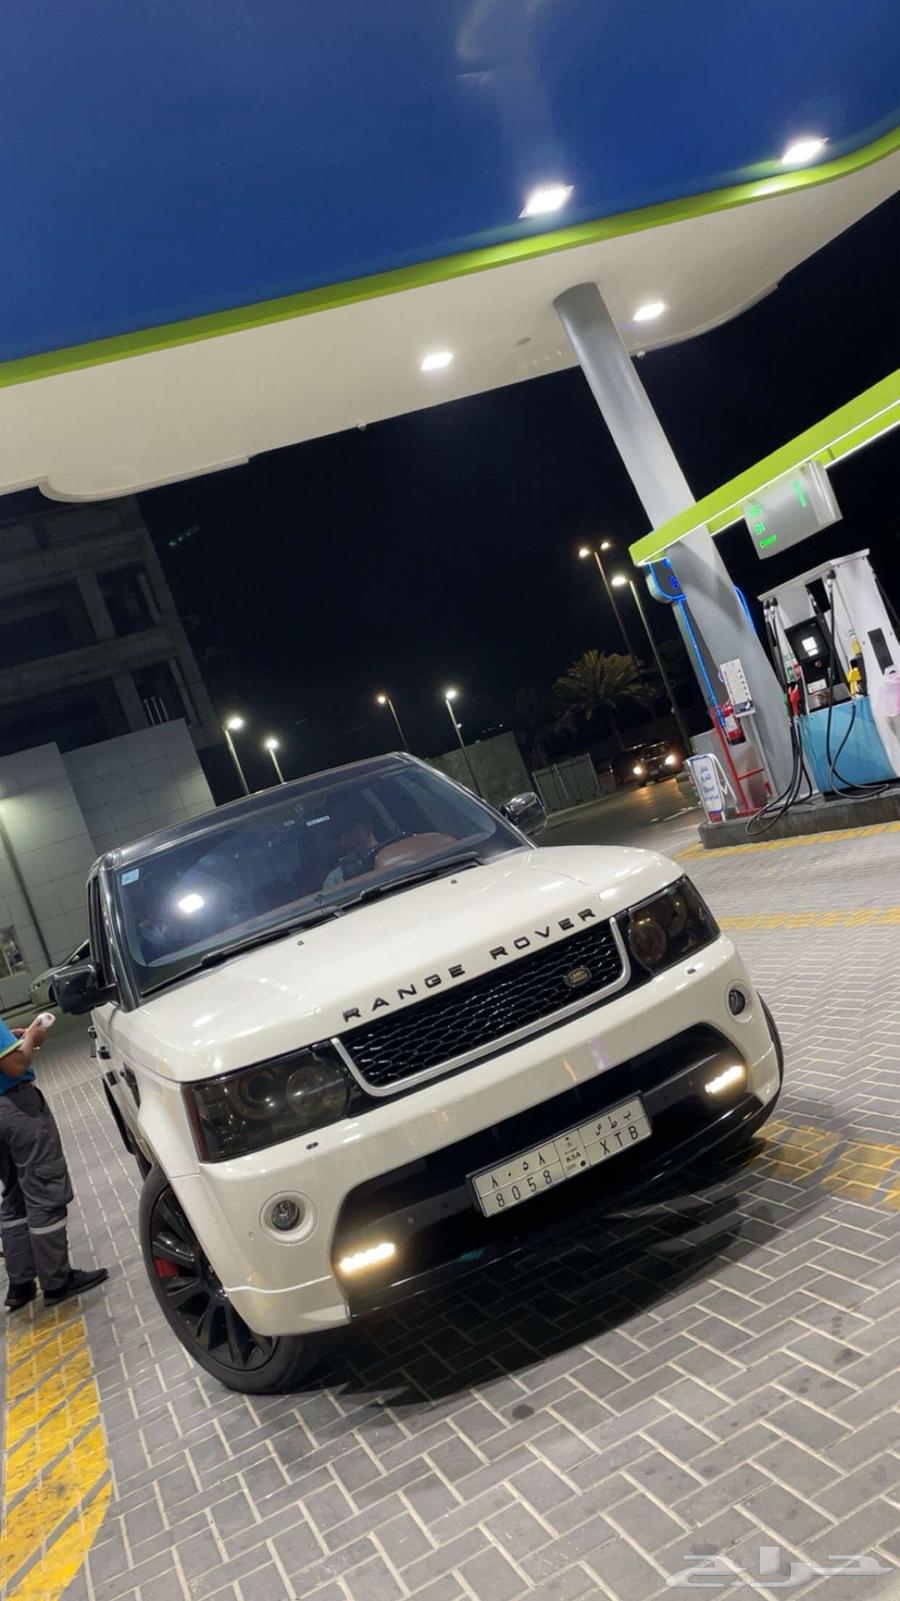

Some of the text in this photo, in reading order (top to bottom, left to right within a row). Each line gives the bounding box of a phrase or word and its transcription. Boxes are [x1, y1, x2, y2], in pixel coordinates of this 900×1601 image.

[342, 908, 597, 1023] RANGE ROVER
[566, 1151, 582, 1162] KSA
[600, 1125, 639, 1156] XTB
[496, 1169, 552, 1208] 8058
